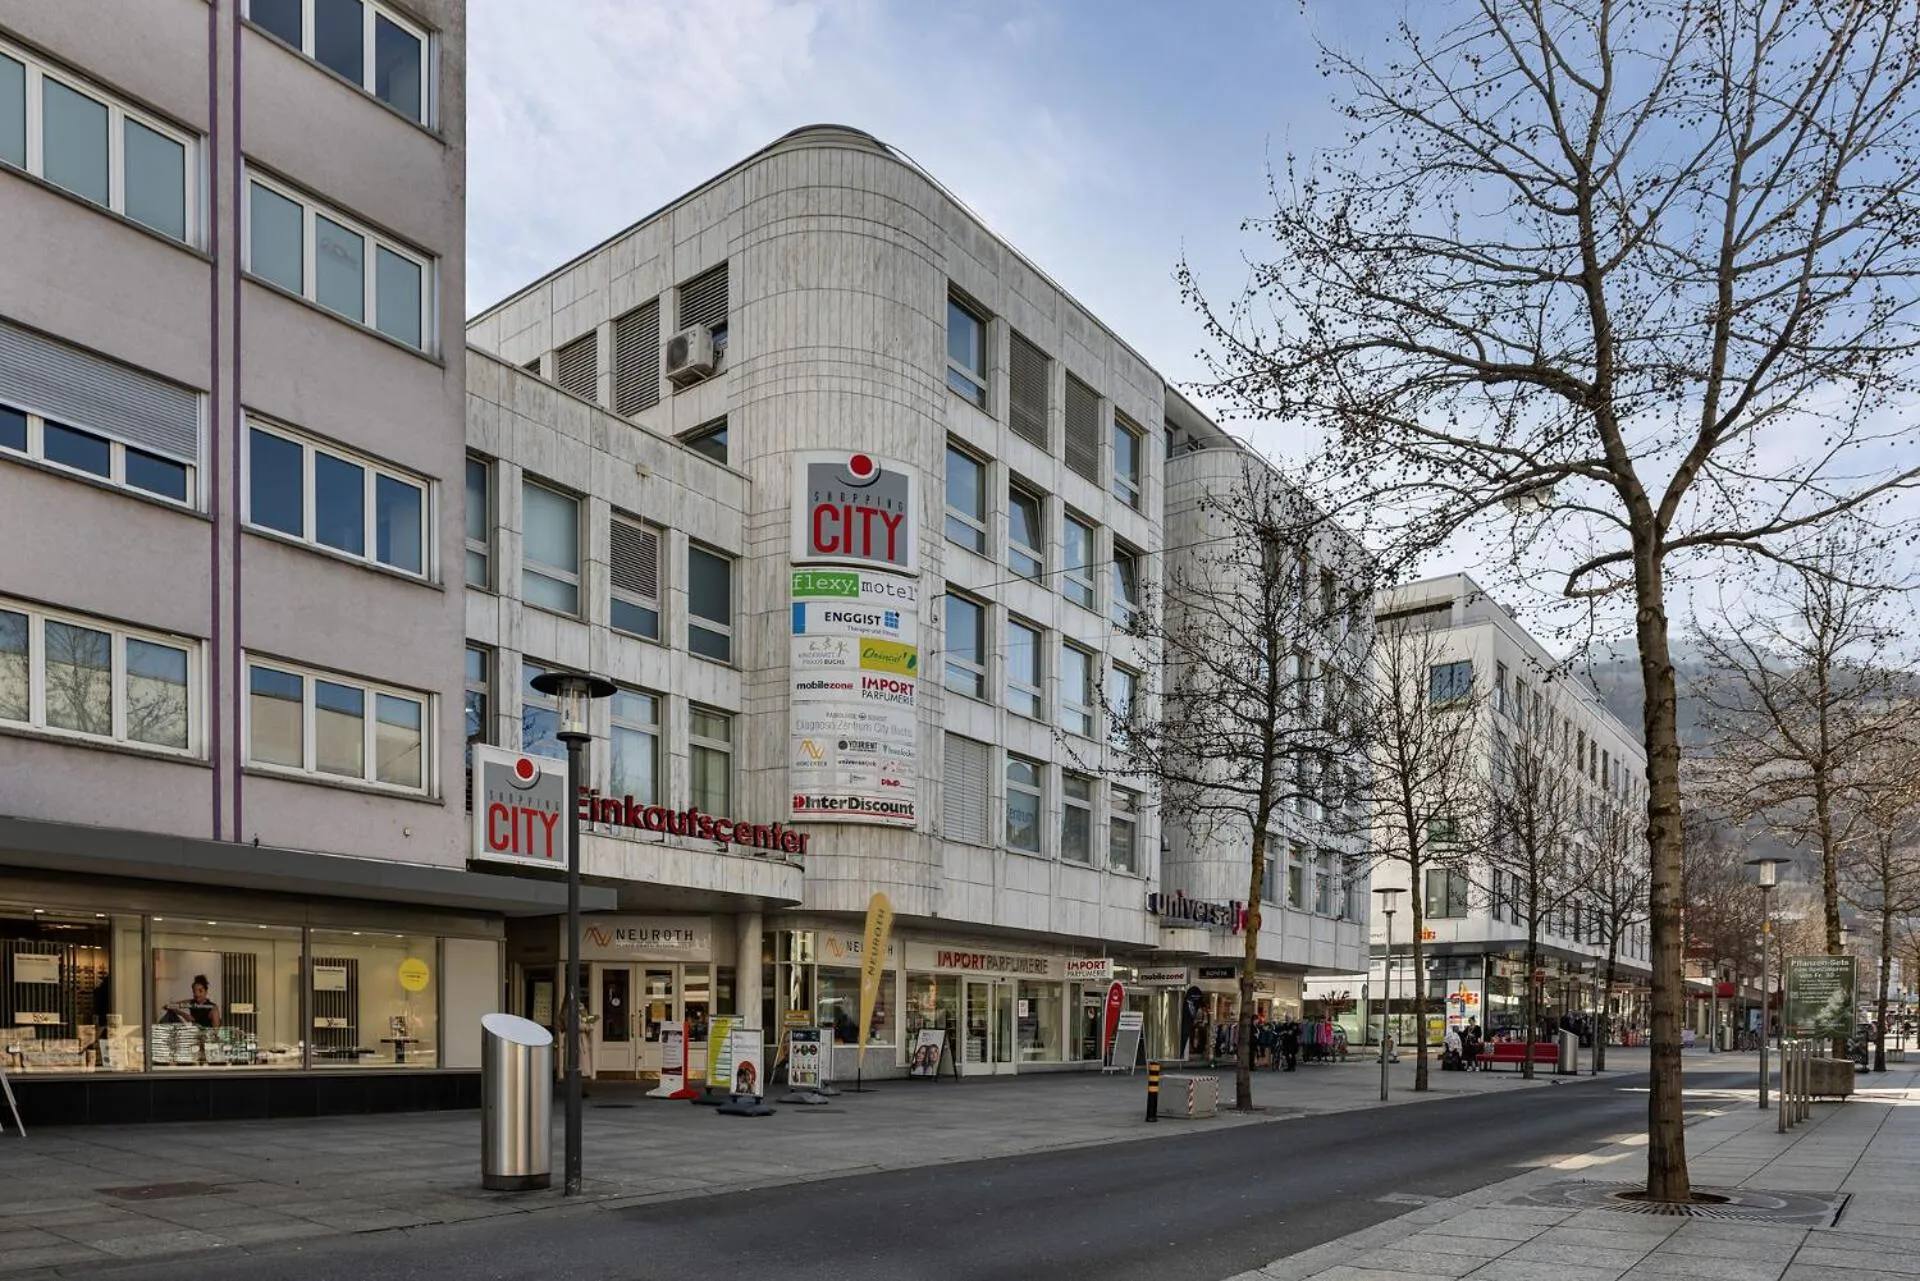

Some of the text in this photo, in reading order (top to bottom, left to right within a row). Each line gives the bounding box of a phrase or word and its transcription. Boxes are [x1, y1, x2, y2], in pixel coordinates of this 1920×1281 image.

[814, 491, 904, 510] SHOPPING
[813, 503, 904, 561] CITY
[824, 611, 881, 627] ENGGIST
[796, 680, 854, 691] mobilezone
[861, 676, 915, 697] IMPORT
[861, 690, 915, 706] PARFUMERIE
[488, 802, 560, 858] CITY
[616, 927, 694, 942] NEUROTH
[867, 908, 886, 976] NEUROTH
[937, 950, 1049, 975] IMPORT PARFUMERIE
[1066, 960, 1107, 970] IMPORT
